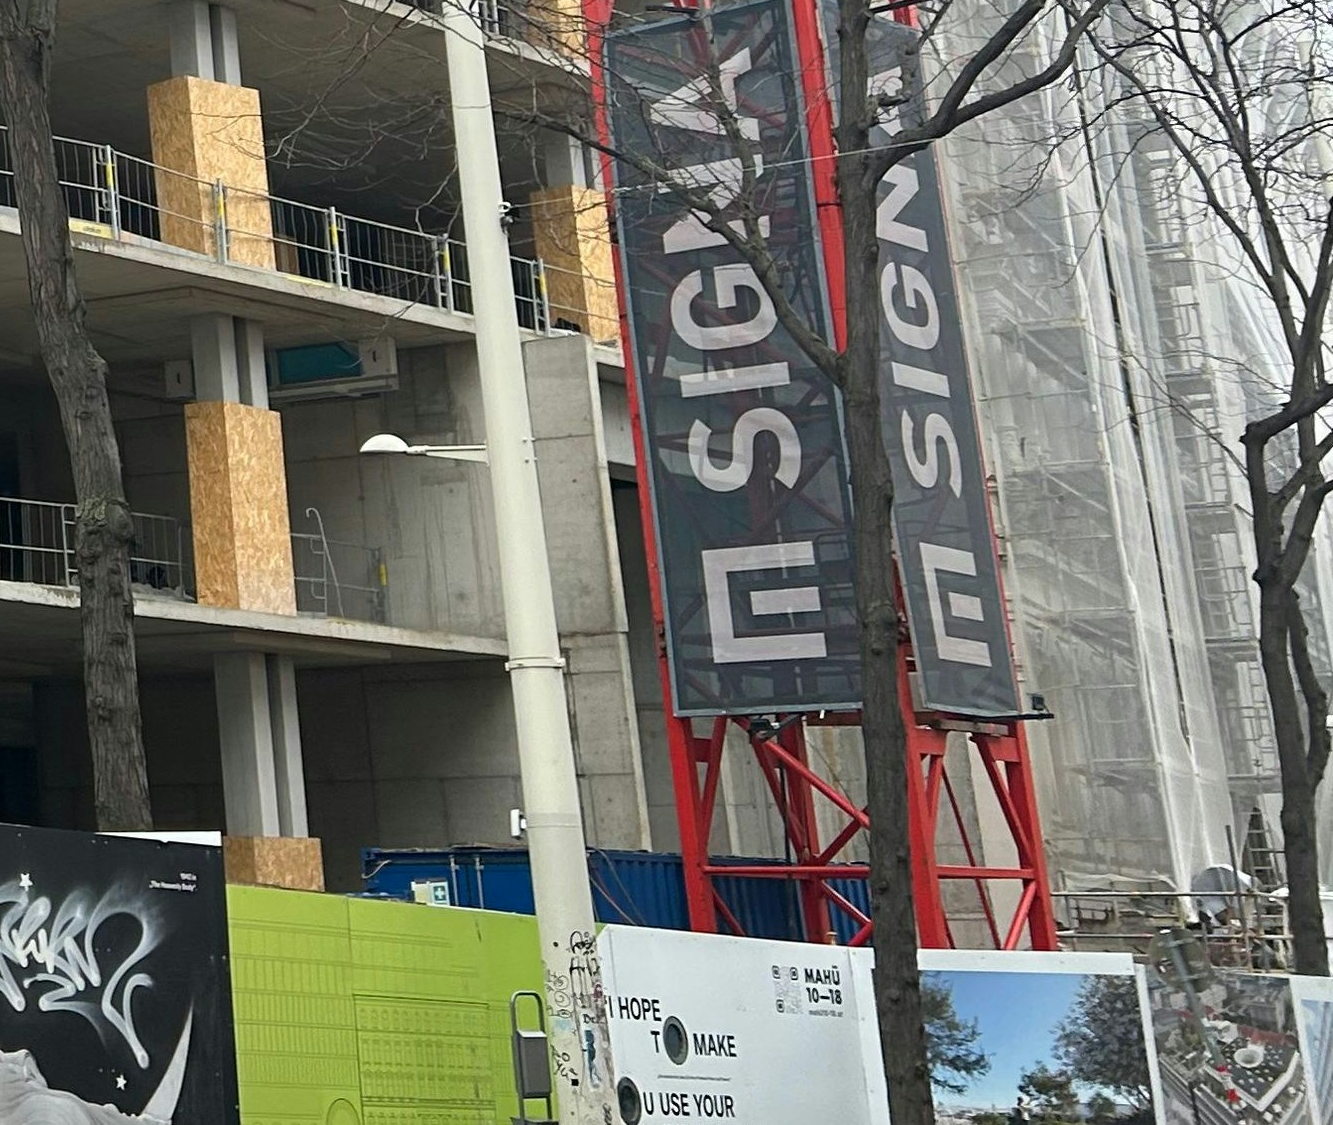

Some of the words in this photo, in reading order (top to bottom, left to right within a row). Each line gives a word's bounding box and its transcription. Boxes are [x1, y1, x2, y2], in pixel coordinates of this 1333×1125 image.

[804, 965, 840, 986] MAHÜ
[618, 996, 662, 1022] HOPE
[693, 1033, 737, 1057] MAKE
[660, 1092, 690, 1116] USE
[694, 1094, 736, 1118] YOUR
